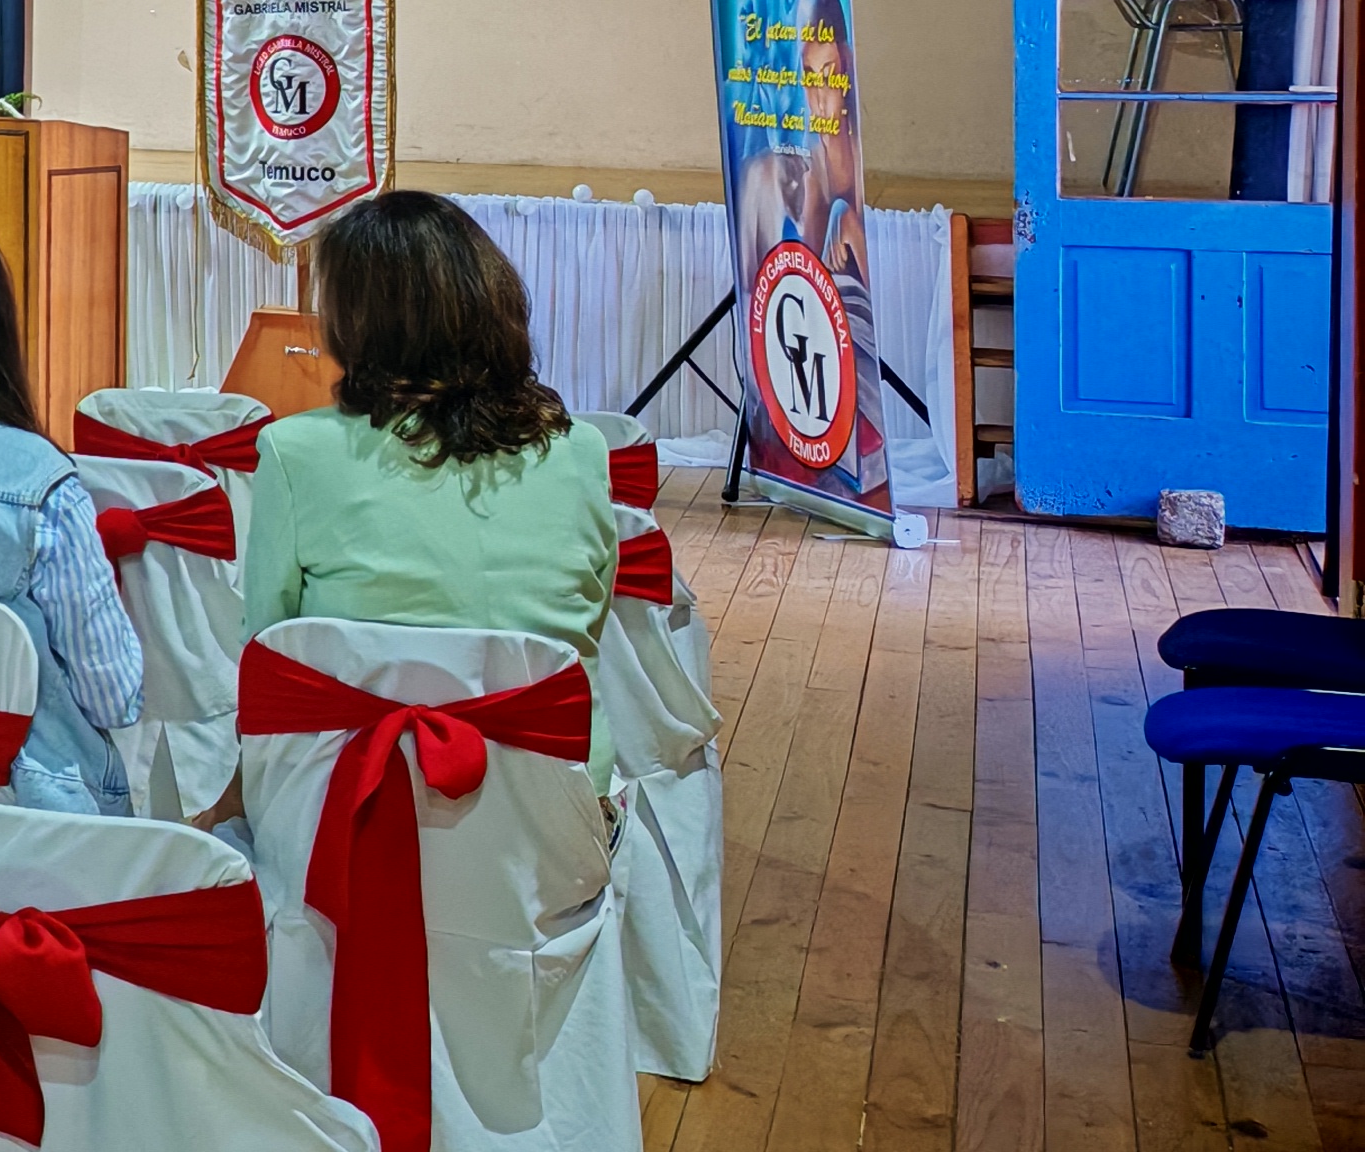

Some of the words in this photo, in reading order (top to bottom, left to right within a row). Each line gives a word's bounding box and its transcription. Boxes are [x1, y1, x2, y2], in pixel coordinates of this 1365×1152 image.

[234, 2, 290, 16] GABRIELA
[294, 0, 350, 13] MISTRAL
[818, 18, 835, 43] los
[259, 160, 336, 182] Temuco
[754, 276, 769, 334] LICEO
[766, 251, 814, 279] GABRIELA
[814, 270, 849, 356] MISTRAL
[788, 429, 830, 463] TEMUCO
